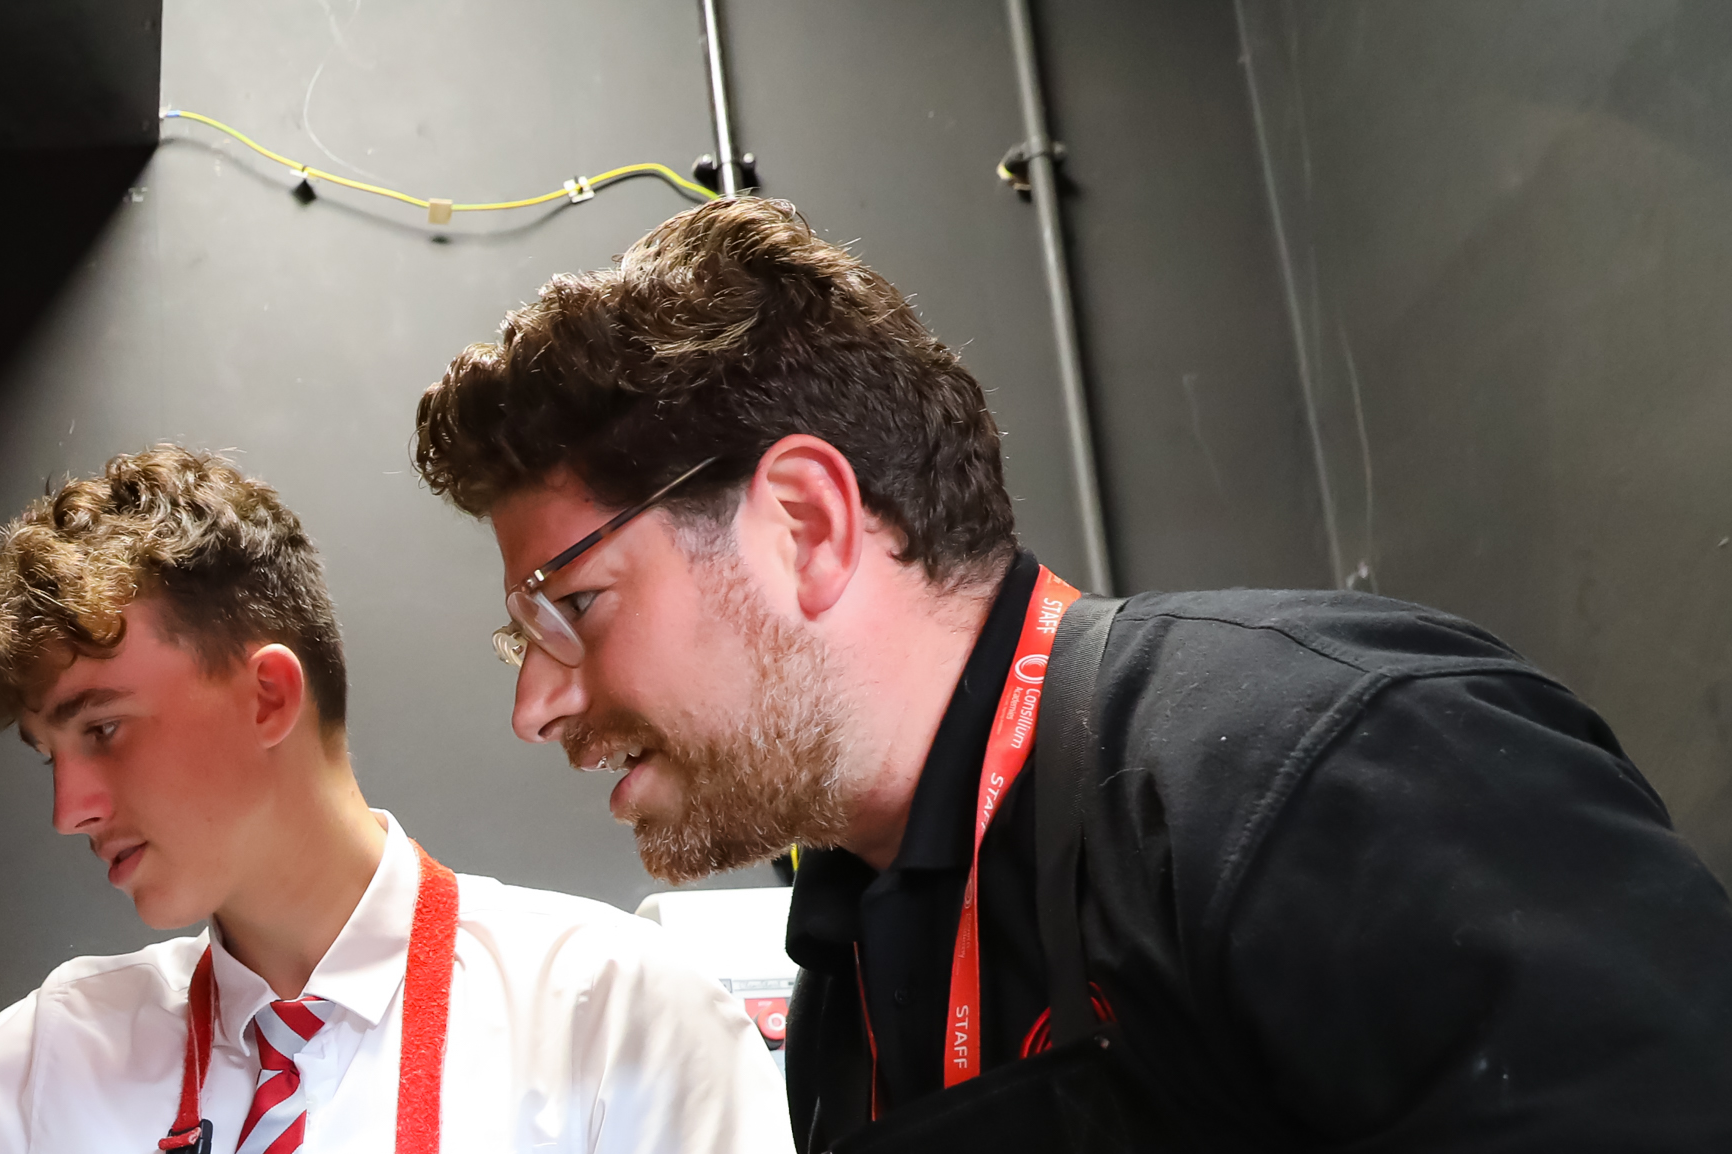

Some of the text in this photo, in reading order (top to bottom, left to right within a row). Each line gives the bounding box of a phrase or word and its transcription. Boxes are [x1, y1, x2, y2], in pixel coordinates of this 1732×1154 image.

[1036, 597, 1064, 634] STAFF
[1006, 686, 1024, 720] Academies
[1011, 687, 1042, 749] Consilium
[953, 1004, 969, 1068] STAFF
